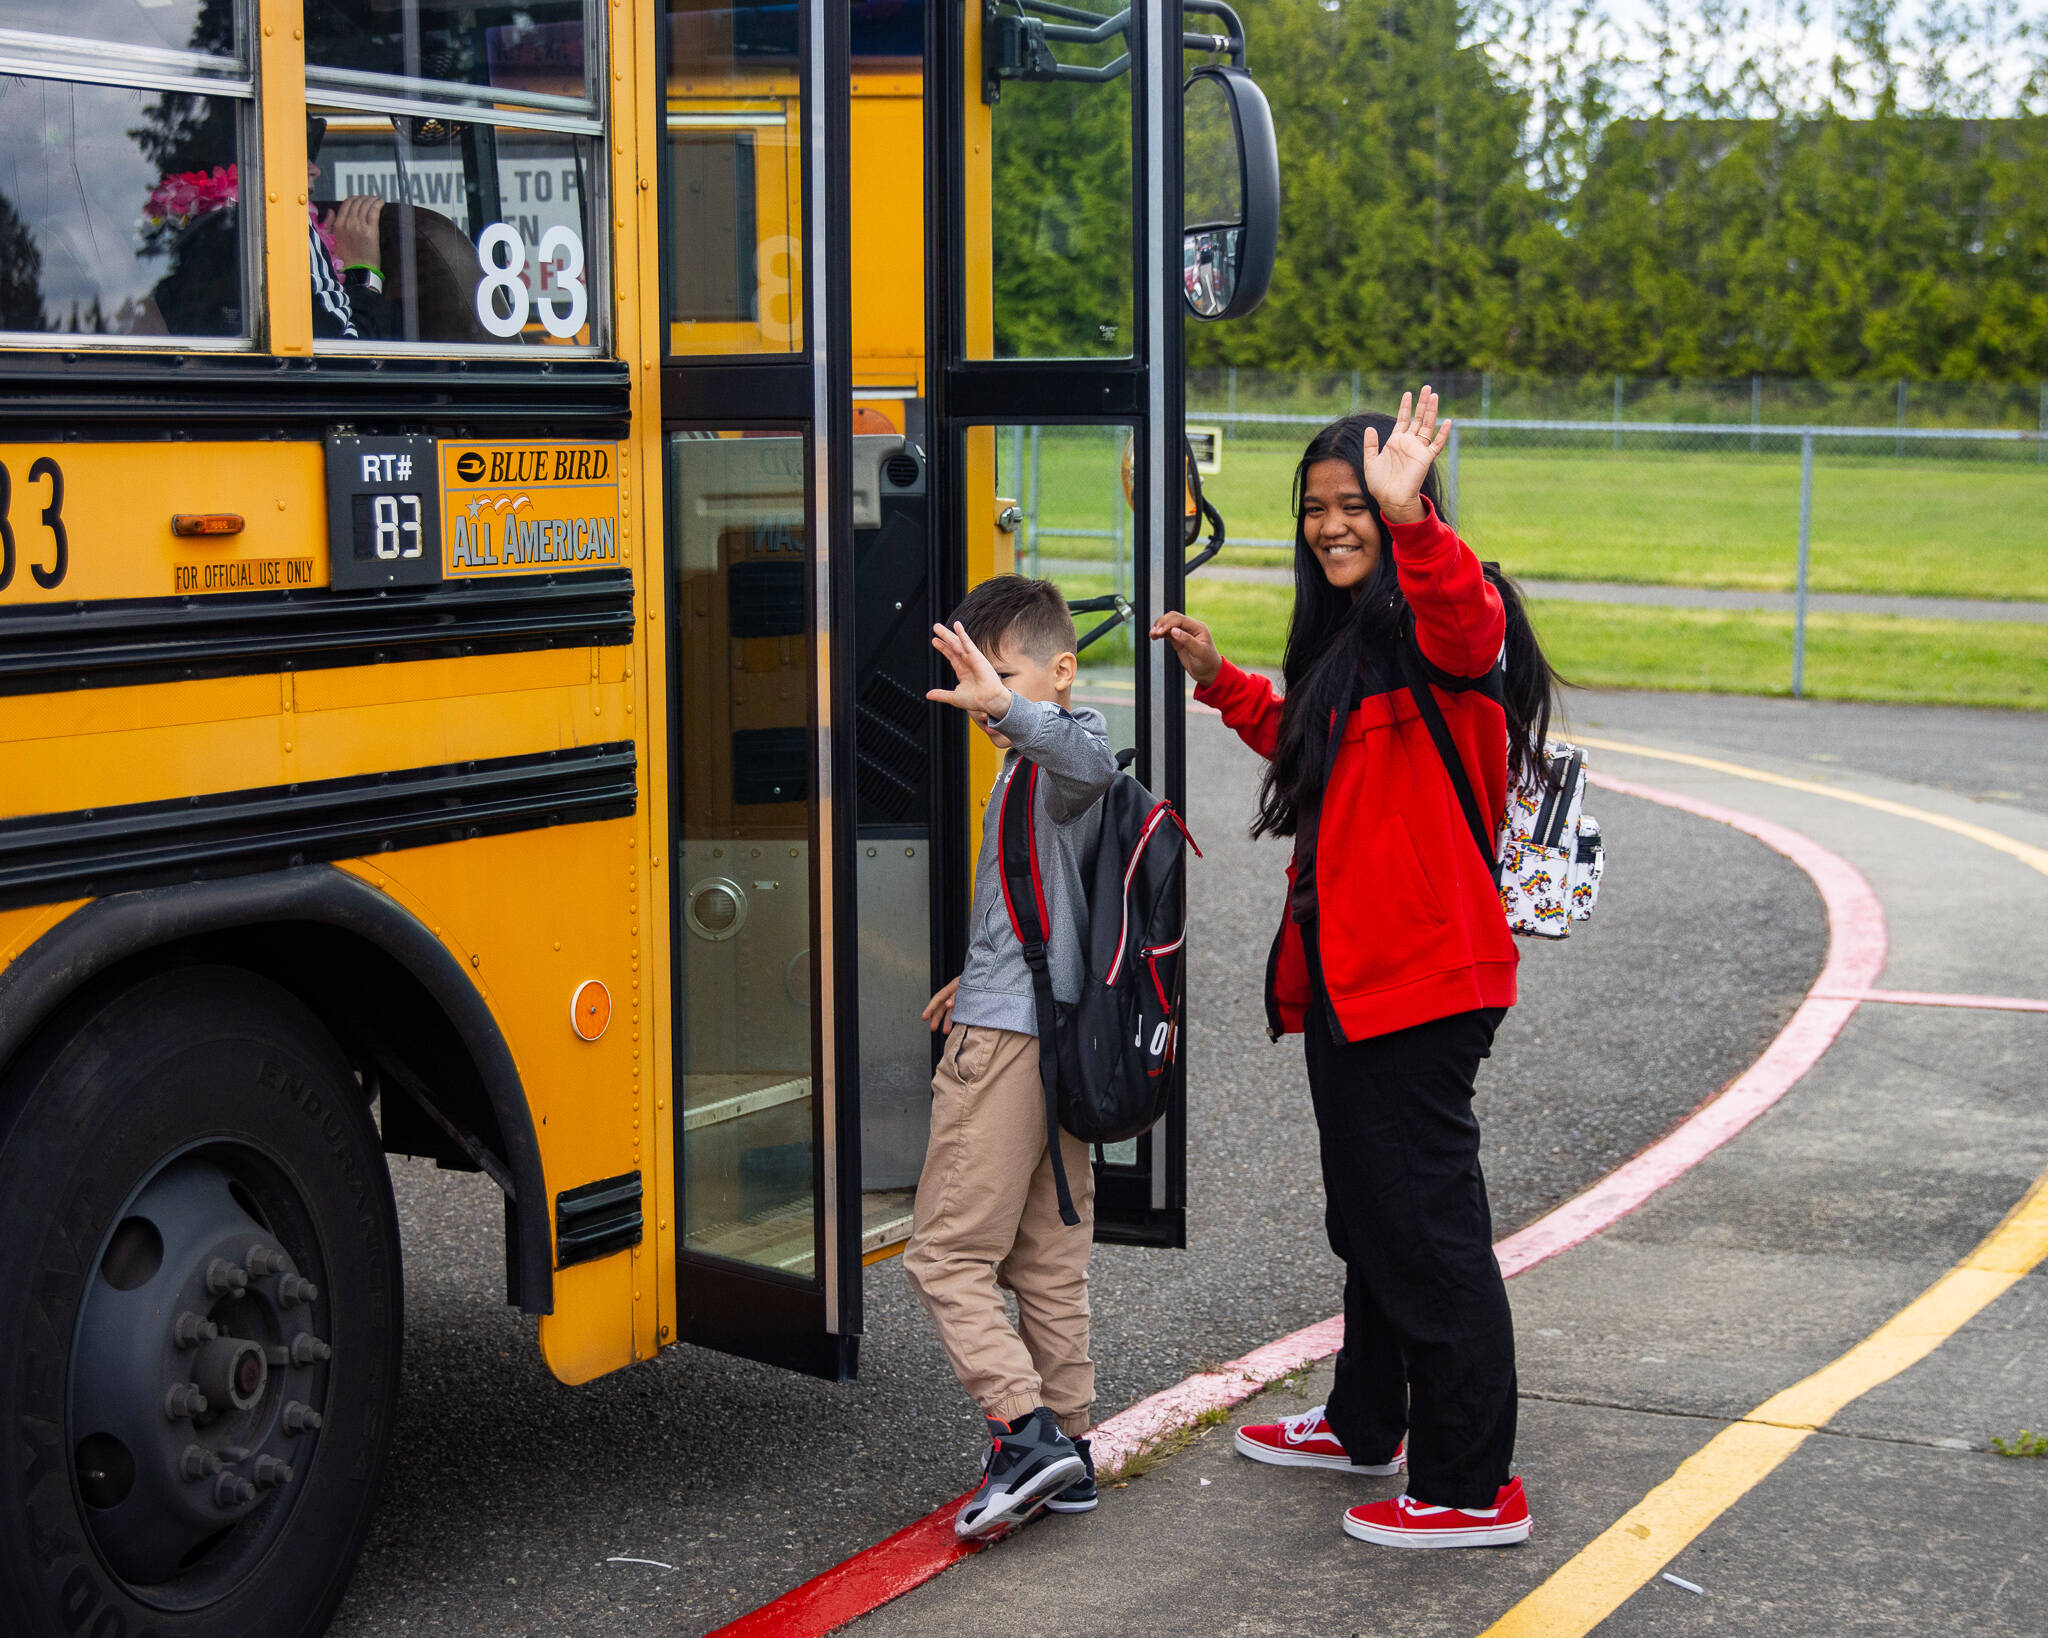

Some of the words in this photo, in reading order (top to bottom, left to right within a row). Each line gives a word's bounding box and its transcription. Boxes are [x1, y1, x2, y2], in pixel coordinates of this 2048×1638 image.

[514, 170, 551, 203] TO
[476, 222, 588, 338] 83
[363, 454, 413, 482] RT#
[490, 451, 548, 482] BLUE
[374, 495, 423, 560] 83
[452, 515, 498, 567] ALL
[502, 513, 615, 564] AMERICAN
[176, 566, 198, 590] FOR
[204, 563, 254, 589] OFFICIAL
[259, 561, 281, 586] USE
[286, 560, 313, 585] ONLY
